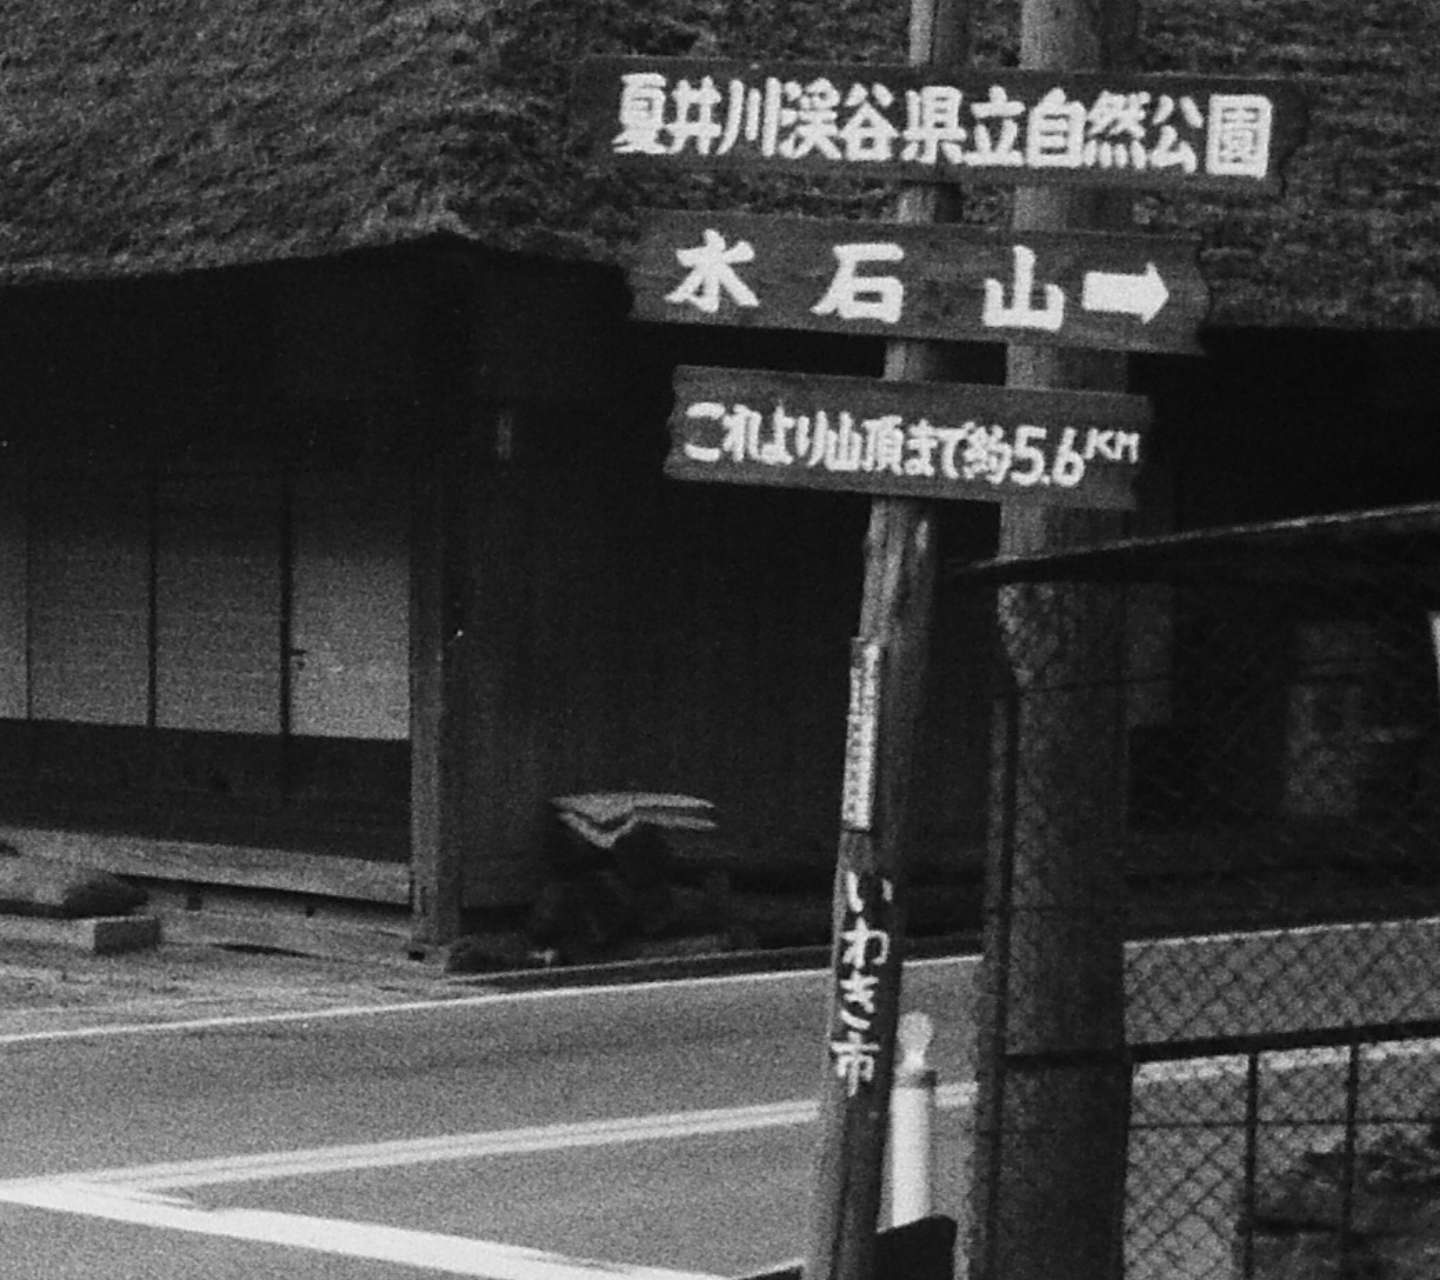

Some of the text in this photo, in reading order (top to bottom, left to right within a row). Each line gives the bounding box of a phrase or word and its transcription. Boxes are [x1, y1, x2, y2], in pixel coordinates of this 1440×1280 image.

[613, 72, 1274, 180] 夏井川渓谷県立自然公園
[665, 228, 1066, 331] 水石山
[832, 871, 893, 1097] いわき市
